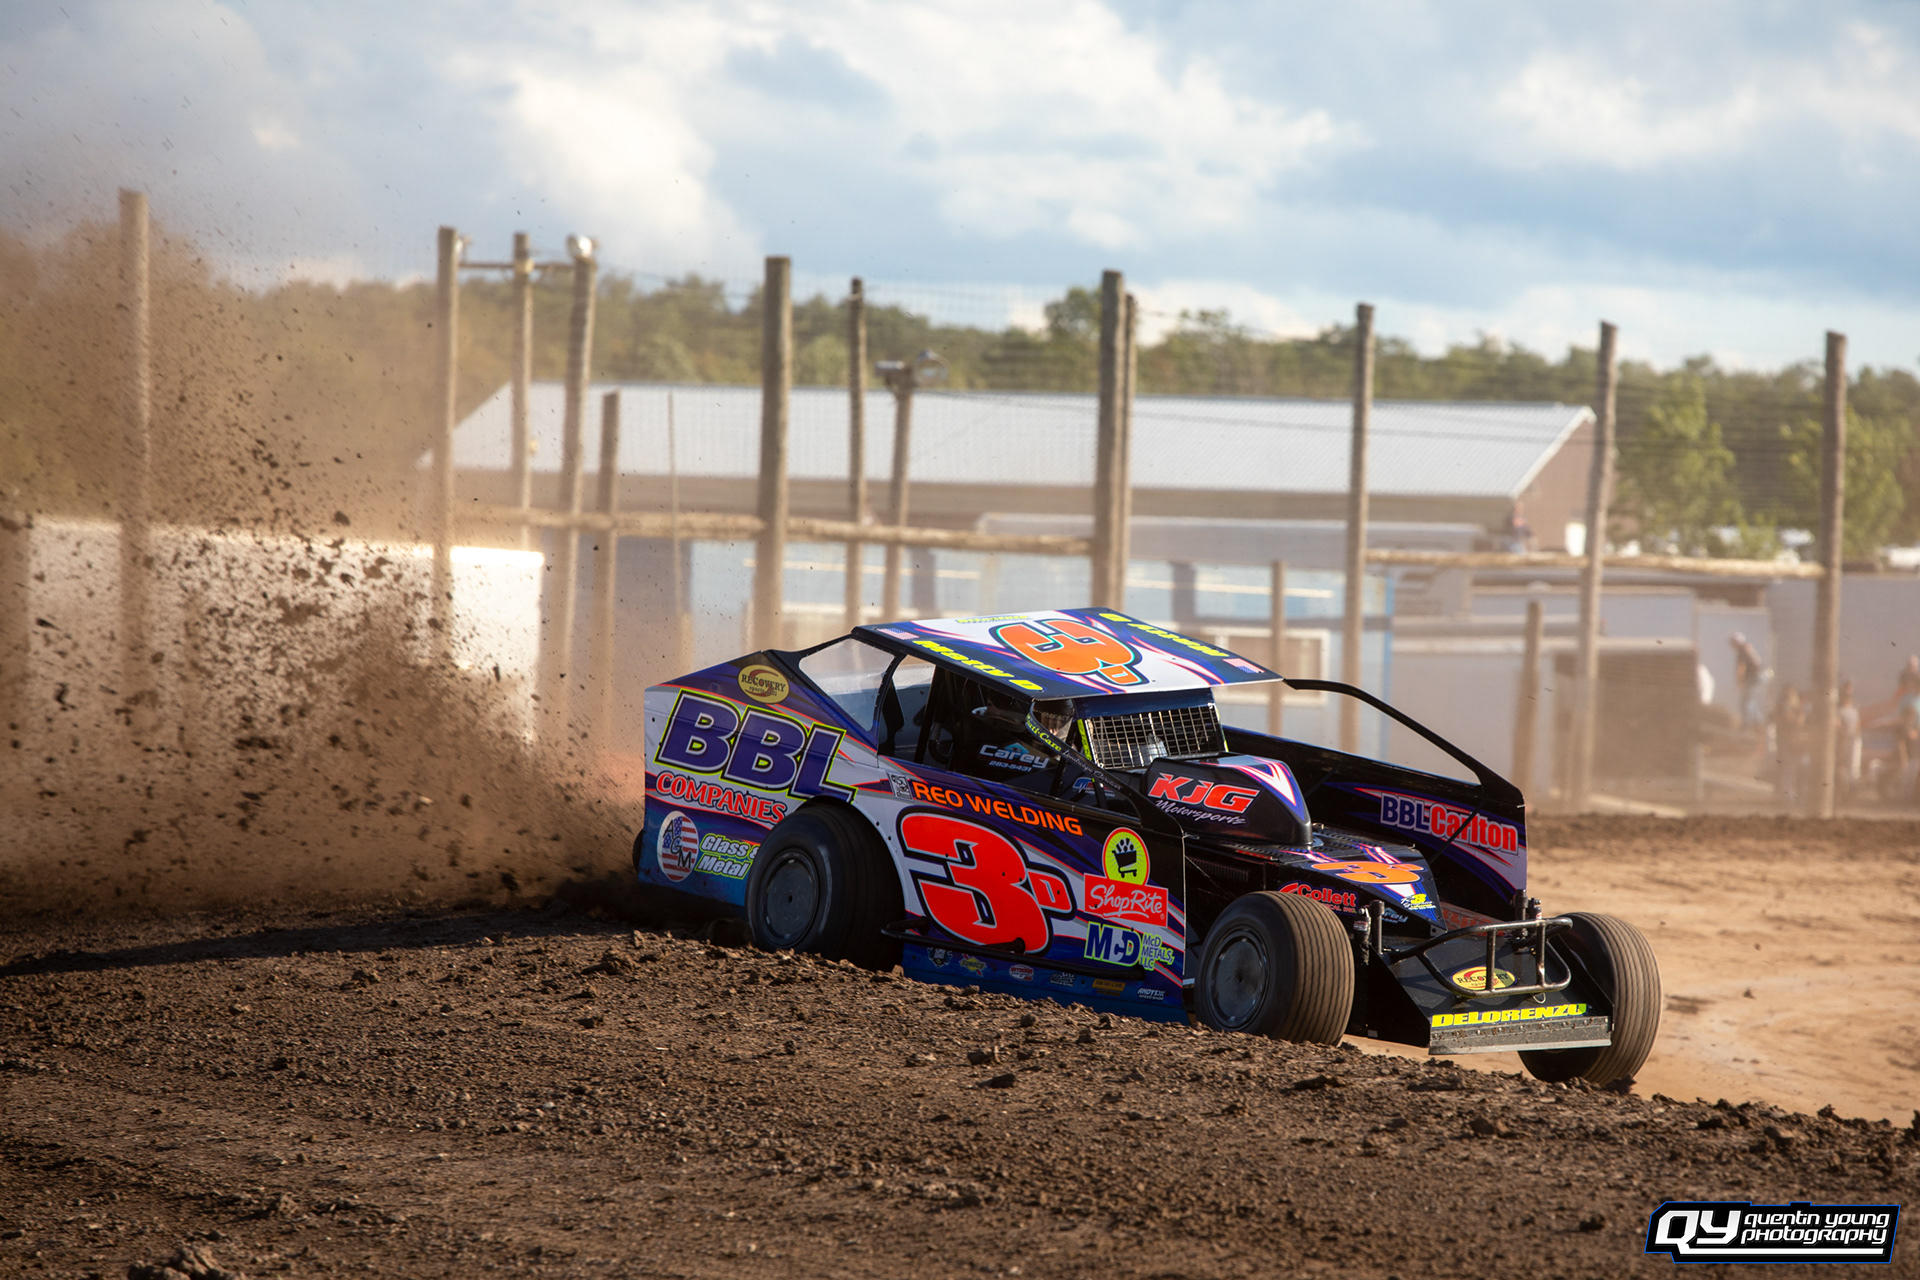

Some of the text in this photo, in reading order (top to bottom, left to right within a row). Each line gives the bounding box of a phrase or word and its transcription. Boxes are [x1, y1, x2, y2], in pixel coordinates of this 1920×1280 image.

[912, 640, 1044, 691] Matty D
[741, 674, 786, 692] RECOVERY
[655, 688, 858, 804] BBL
[979, 744, 1049, 769] Carey
[656, 772, 786, 824] COMPANIES
[1148, 772, 1261, 814] KJG
[912, 781, 964, 808] REO
[966, 792, 1083, 837] WELDING
[1155, 799, 1247, 826] Motorsports
[701, 834, 750, 858] Glass
[697, 854, 750, 878] Metal
[1088, 884, 1163, 916] ShopRite
[1297, 884, 1357, 908] Collett
[1086, 923, 1141, 967] McD
[1142, 934, 1162, 948] McD
[1140, 957, 1155, 970] LLC
[1142, 946, 1174, 964] METALS,
[1456, 973, 1510, 984] RECORY
[1431, 1003, 1587, 1028] DELORENZO
